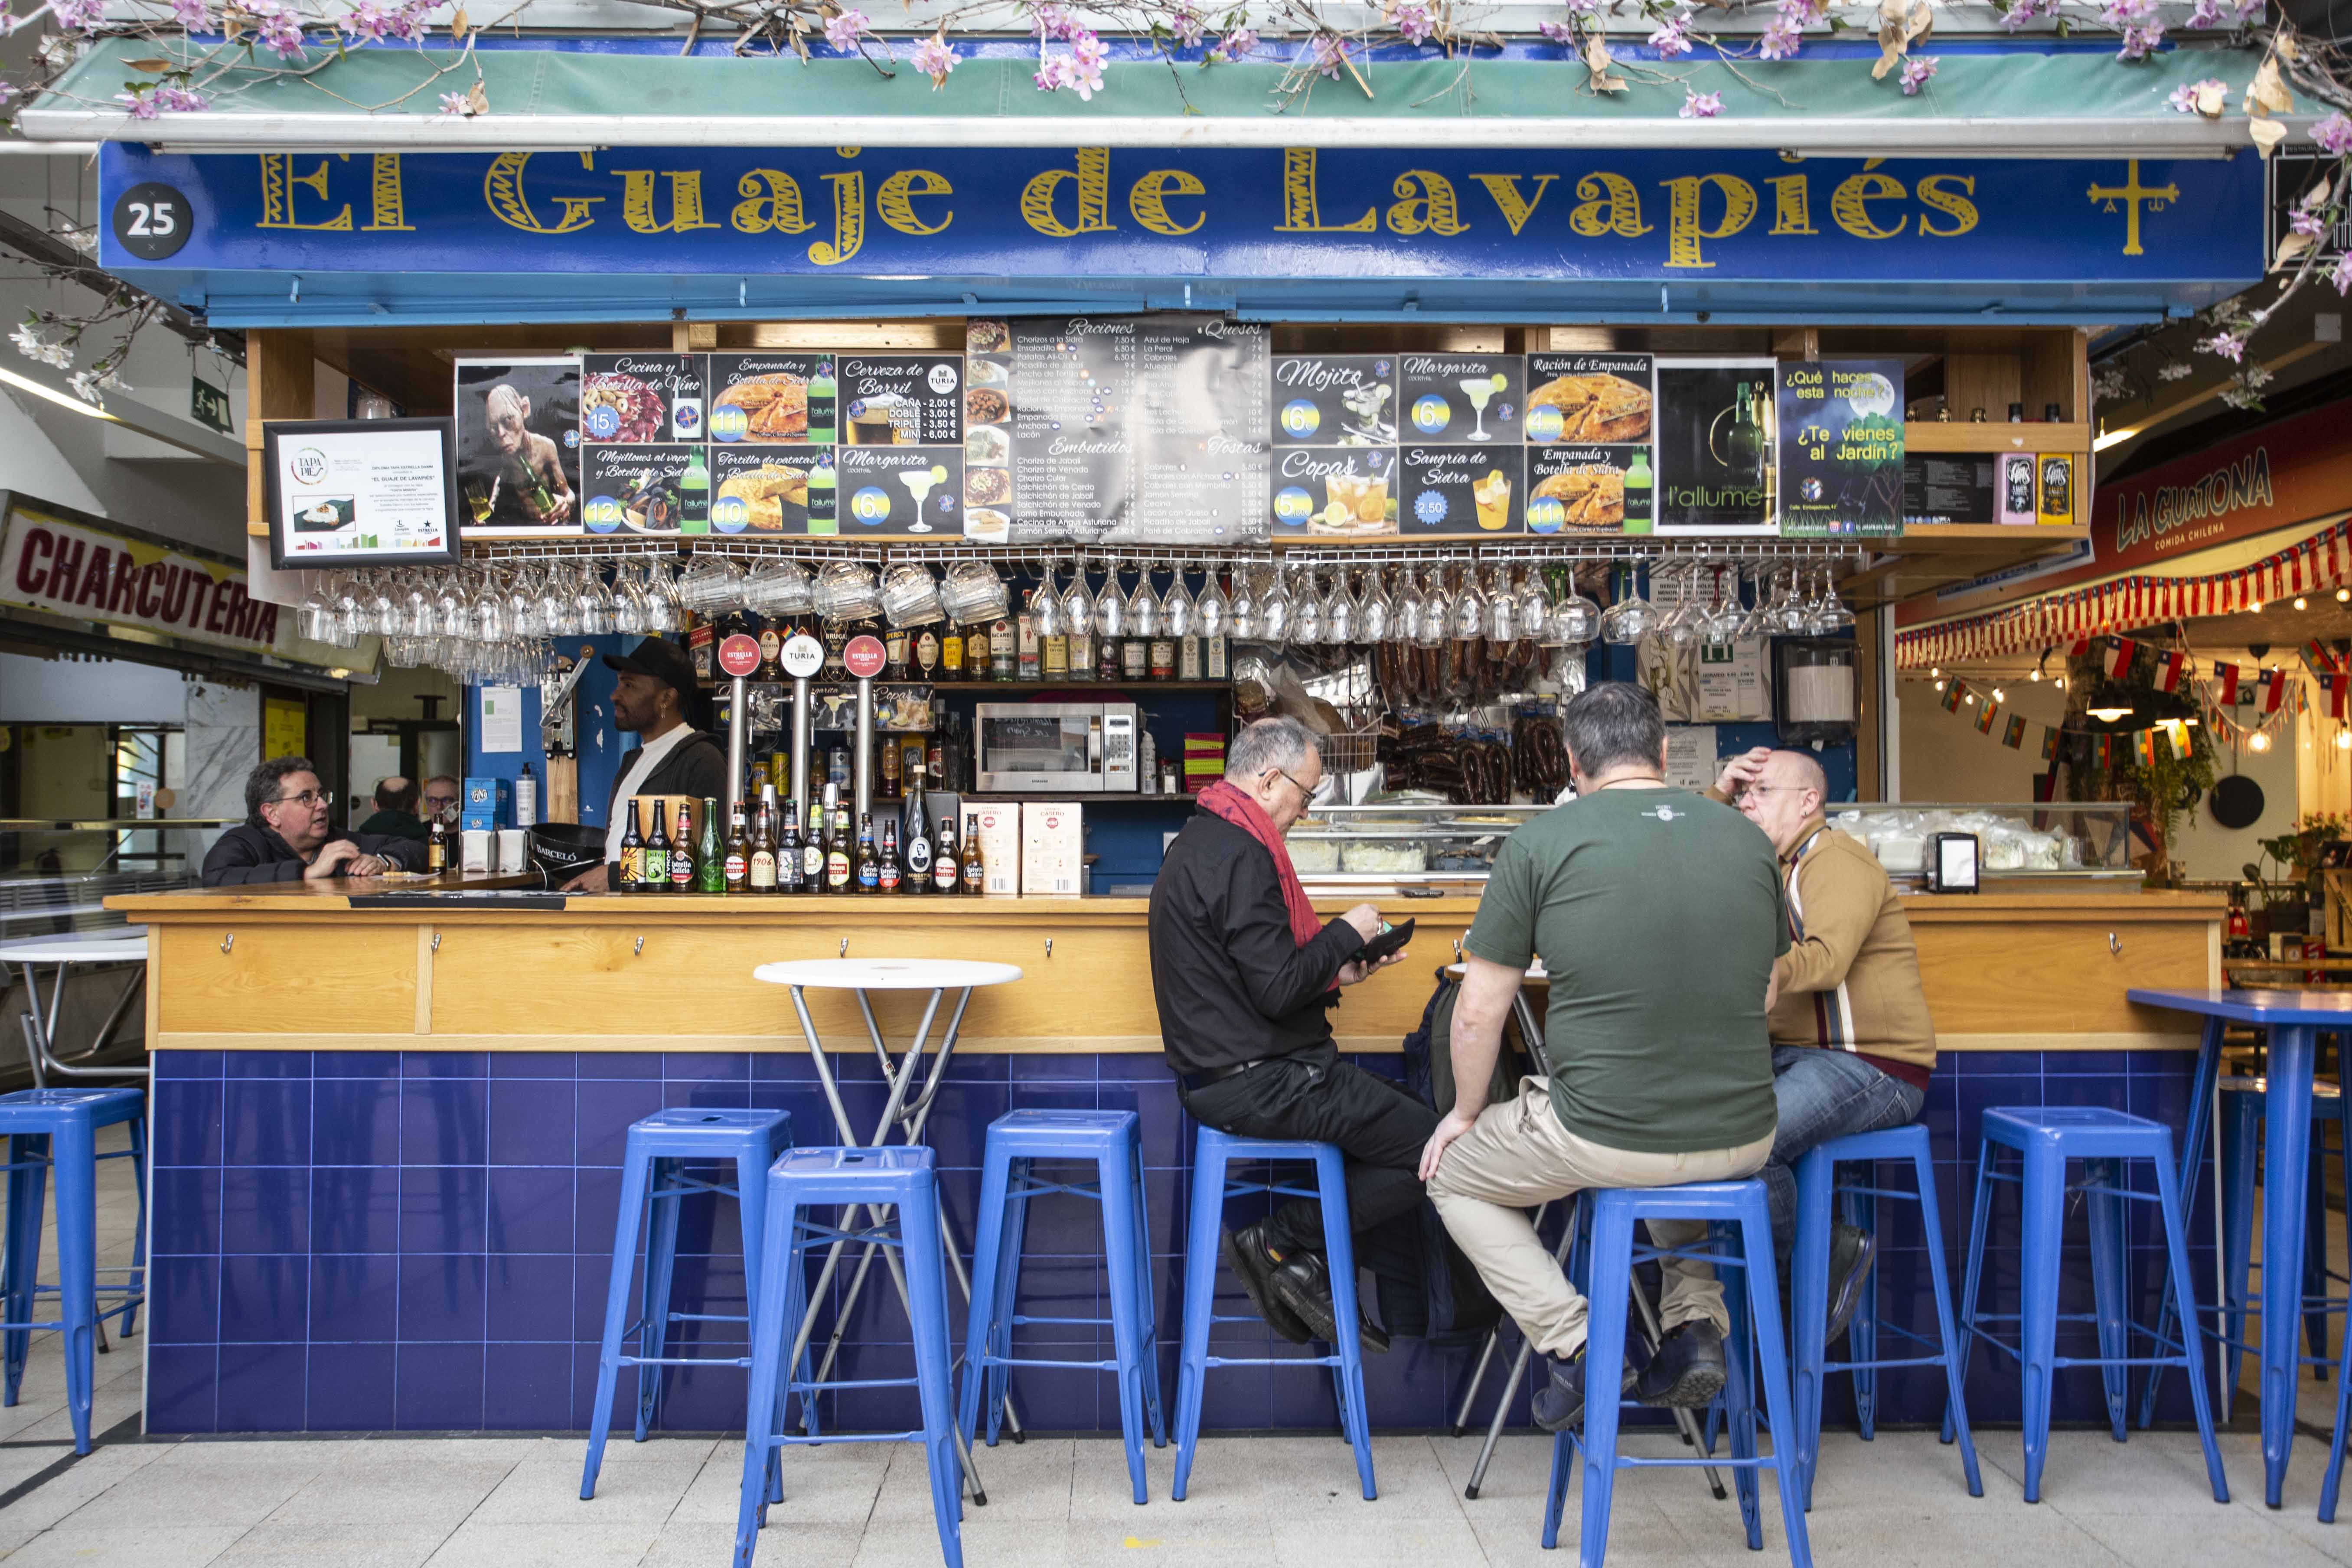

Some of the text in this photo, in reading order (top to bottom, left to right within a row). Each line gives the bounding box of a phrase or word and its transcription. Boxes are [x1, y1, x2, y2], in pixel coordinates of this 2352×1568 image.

[256, 147, 1980, 269] El Guaje de Lavapiés
[128, 202, 174, 238] 25
[1065, 317, 1136, 336] Raciones
[1205, 319, 1263, 339] Quesos
[1017, 336, 1083, 344] Chorizos a la Sidra
[1144, 336, 1190, 344] Azul de Hoja
[615, 357, 675, 375] Cecina y
[738, 358, 806, 373] Empanada y
[845, 360, 924, 378] Cerveza de
[1403, 356, 1489, 378] Margarita
[1533, 358, 1647, 375] Ración de Empanada
[590, 374, 700, 391] Botella de Vino
[727, 373, 818, 386] Botella de Sidra
[930, 376, 955, 385] TURIA
[1276, 359, 1364, 392] Mojito
[1787, 370, 1872, 387] ¿Qué haces
[857, 378, 912, 395] Barril
[1796, 386, 1824, 399] esta
[895, 397, 956, 409] CAÑA 2,00 €
[889, 409, 956, 419] DOBLE 3,00 €
[888, 420, 956, 430] TRIPLE 3,50 €
[900, 430, 956, 440] MINI 6,00 €
[1798, 425, 1895, 446] ¿Te vienes
[1048, 436, 1133, 456] Embutidos
[1207, 435, 1263, 455] Tostas
[1810, 444, 1824, 460] al
[298, 458, 322, 466] TAPA
[596, 450, 694, 465] Mejillones al vapor
[718, 452, 816, 468] Tortilla de patatas
[842, 449, 928, 469] Margarita
[1405, 448, 1488, 469] Sangría de
[1543, 447, 1611, 463] Empanada y
[595, 469, 603, 479] y
[605, 466, 645, 477] Botella
[645, 467, 659, 477] de
[1017, 465, 1089, 473] Chorizo de Venado
[1281, 450, 1358, 482] Copas
[1533, 462, 1619, 476] Botella de Sidra
[717, 472, 724, 482] y
[726, 468, 767, 480] Botella
[767, 469, 779, 480] de
[1421, 467, 1471, 486] Sidra
[1017, 482, 1095, 491] Salchichón de Cerdo
[1669, 485, 1762, 507] l'allume
[2117, 446, 2273, 553] LA GUATONA
[1017, 500, 1101, 509] Salchichón de Venado
[1017, 509, 1085, 517] Lomo Embuchado
[1017, 518, 1044, 527] Cecina
[1047, 518, 1057, 527] de
[1083, 518, 1117, 527] Asturiana
[1017, 526, 1043, 535] Jamón
[1074, 526, 1108, 535] Asturiano
[2155, 522, 2225, 551] COMIDA CHILENA
[16, 527, 278, 644] CHARCUTERIA
[536, 844, 577, 862] BARCELÓ
[753, 857, 772, 866] 1906
